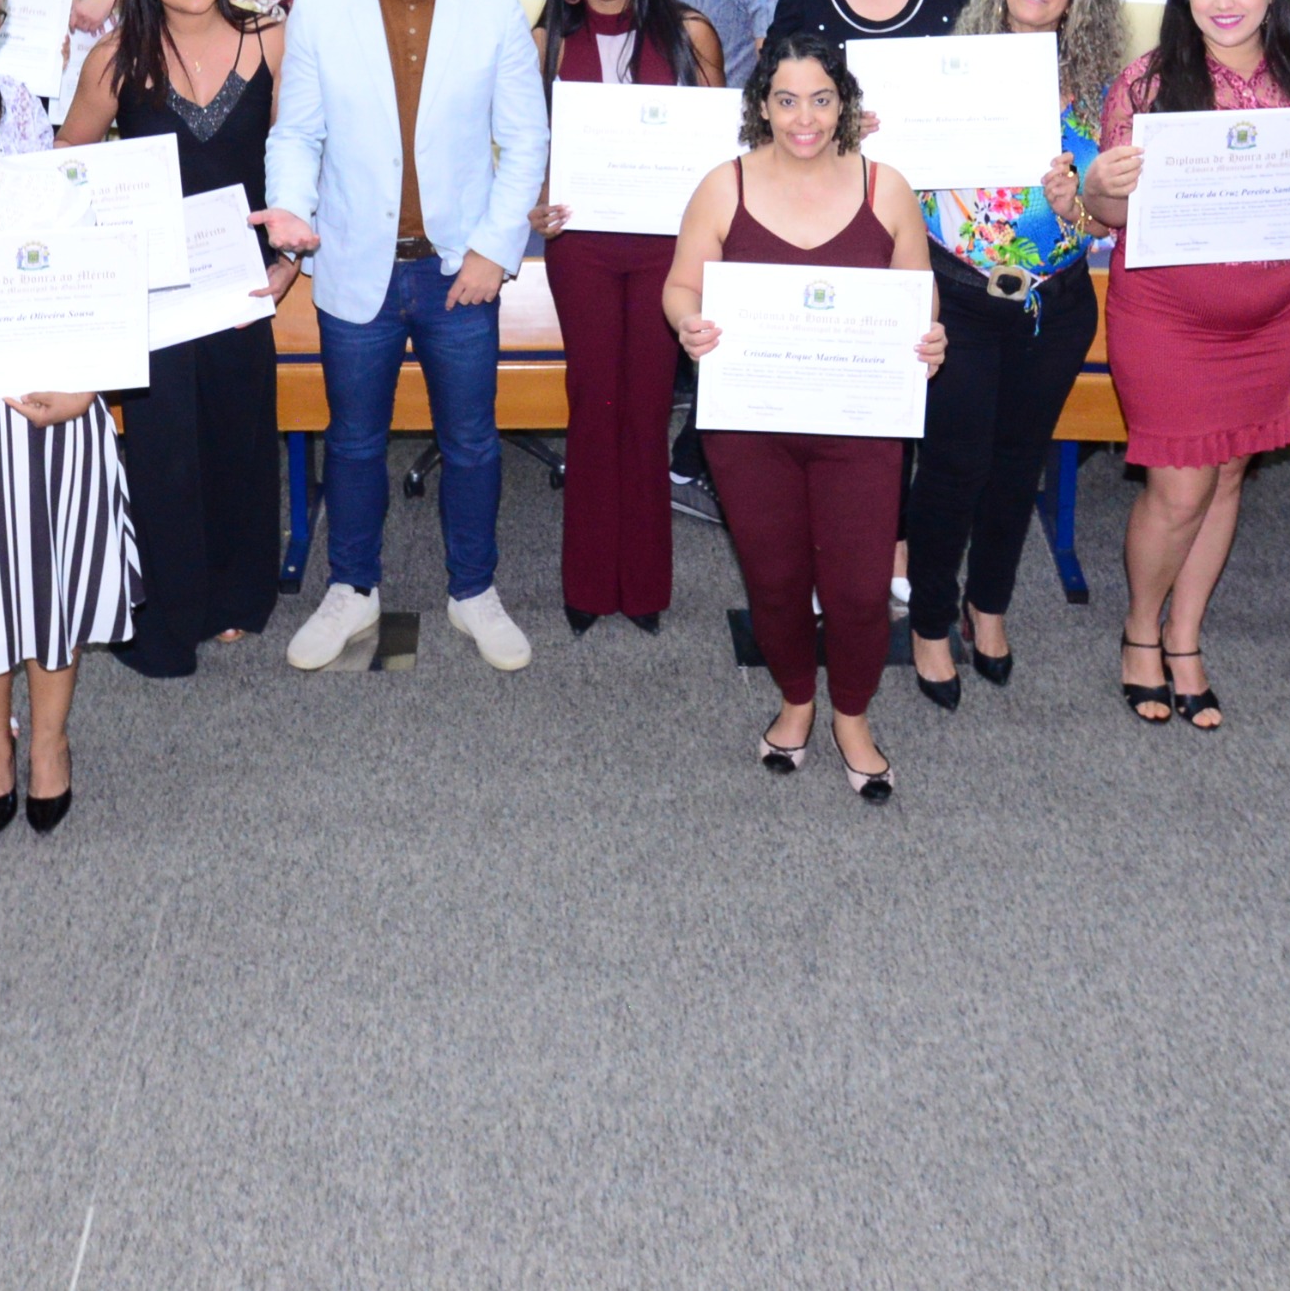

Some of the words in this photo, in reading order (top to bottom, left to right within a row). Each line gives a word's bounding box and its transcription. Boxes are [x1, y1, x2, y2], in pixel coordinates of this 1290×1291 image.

[1165, 156, 1210, 167] Diploma
[1213, 155, 1224, 164] de
[1228, 152, 1262, 163] Honra
[1264, 152, 1277, 160] ao
[1175, 191, 1204, 200] Clarice
[1206, 190, 1217, 198] da
[1219, 189, 1239, 198] Cruz
[1241, 187, 1271, 197] Pereira
[2, 275, 14, 285] de
[20, 271, 57, 284] Honra
[60, 272, 73, 282] ao
[77, 270, 116, 282] Mérito
[16, 312, 28, 322] de
[30, 310, 66, 321] Oliveira
[67, 309, 95, 319] Sousa
[738, 309, 786, 321] Diploma
[789, 312, 800, 323] de
[805, 312, 840, 325] Honra
[843, 317, 856, 326] ao
[859, 315, 898, 328] Mérito
[743, 349, 783, 360] Cristiane
[785, 351, 813, 363] Roque
[815, 352, 849, 363] Martins
[852, 354, 886, 365] Teixeira
